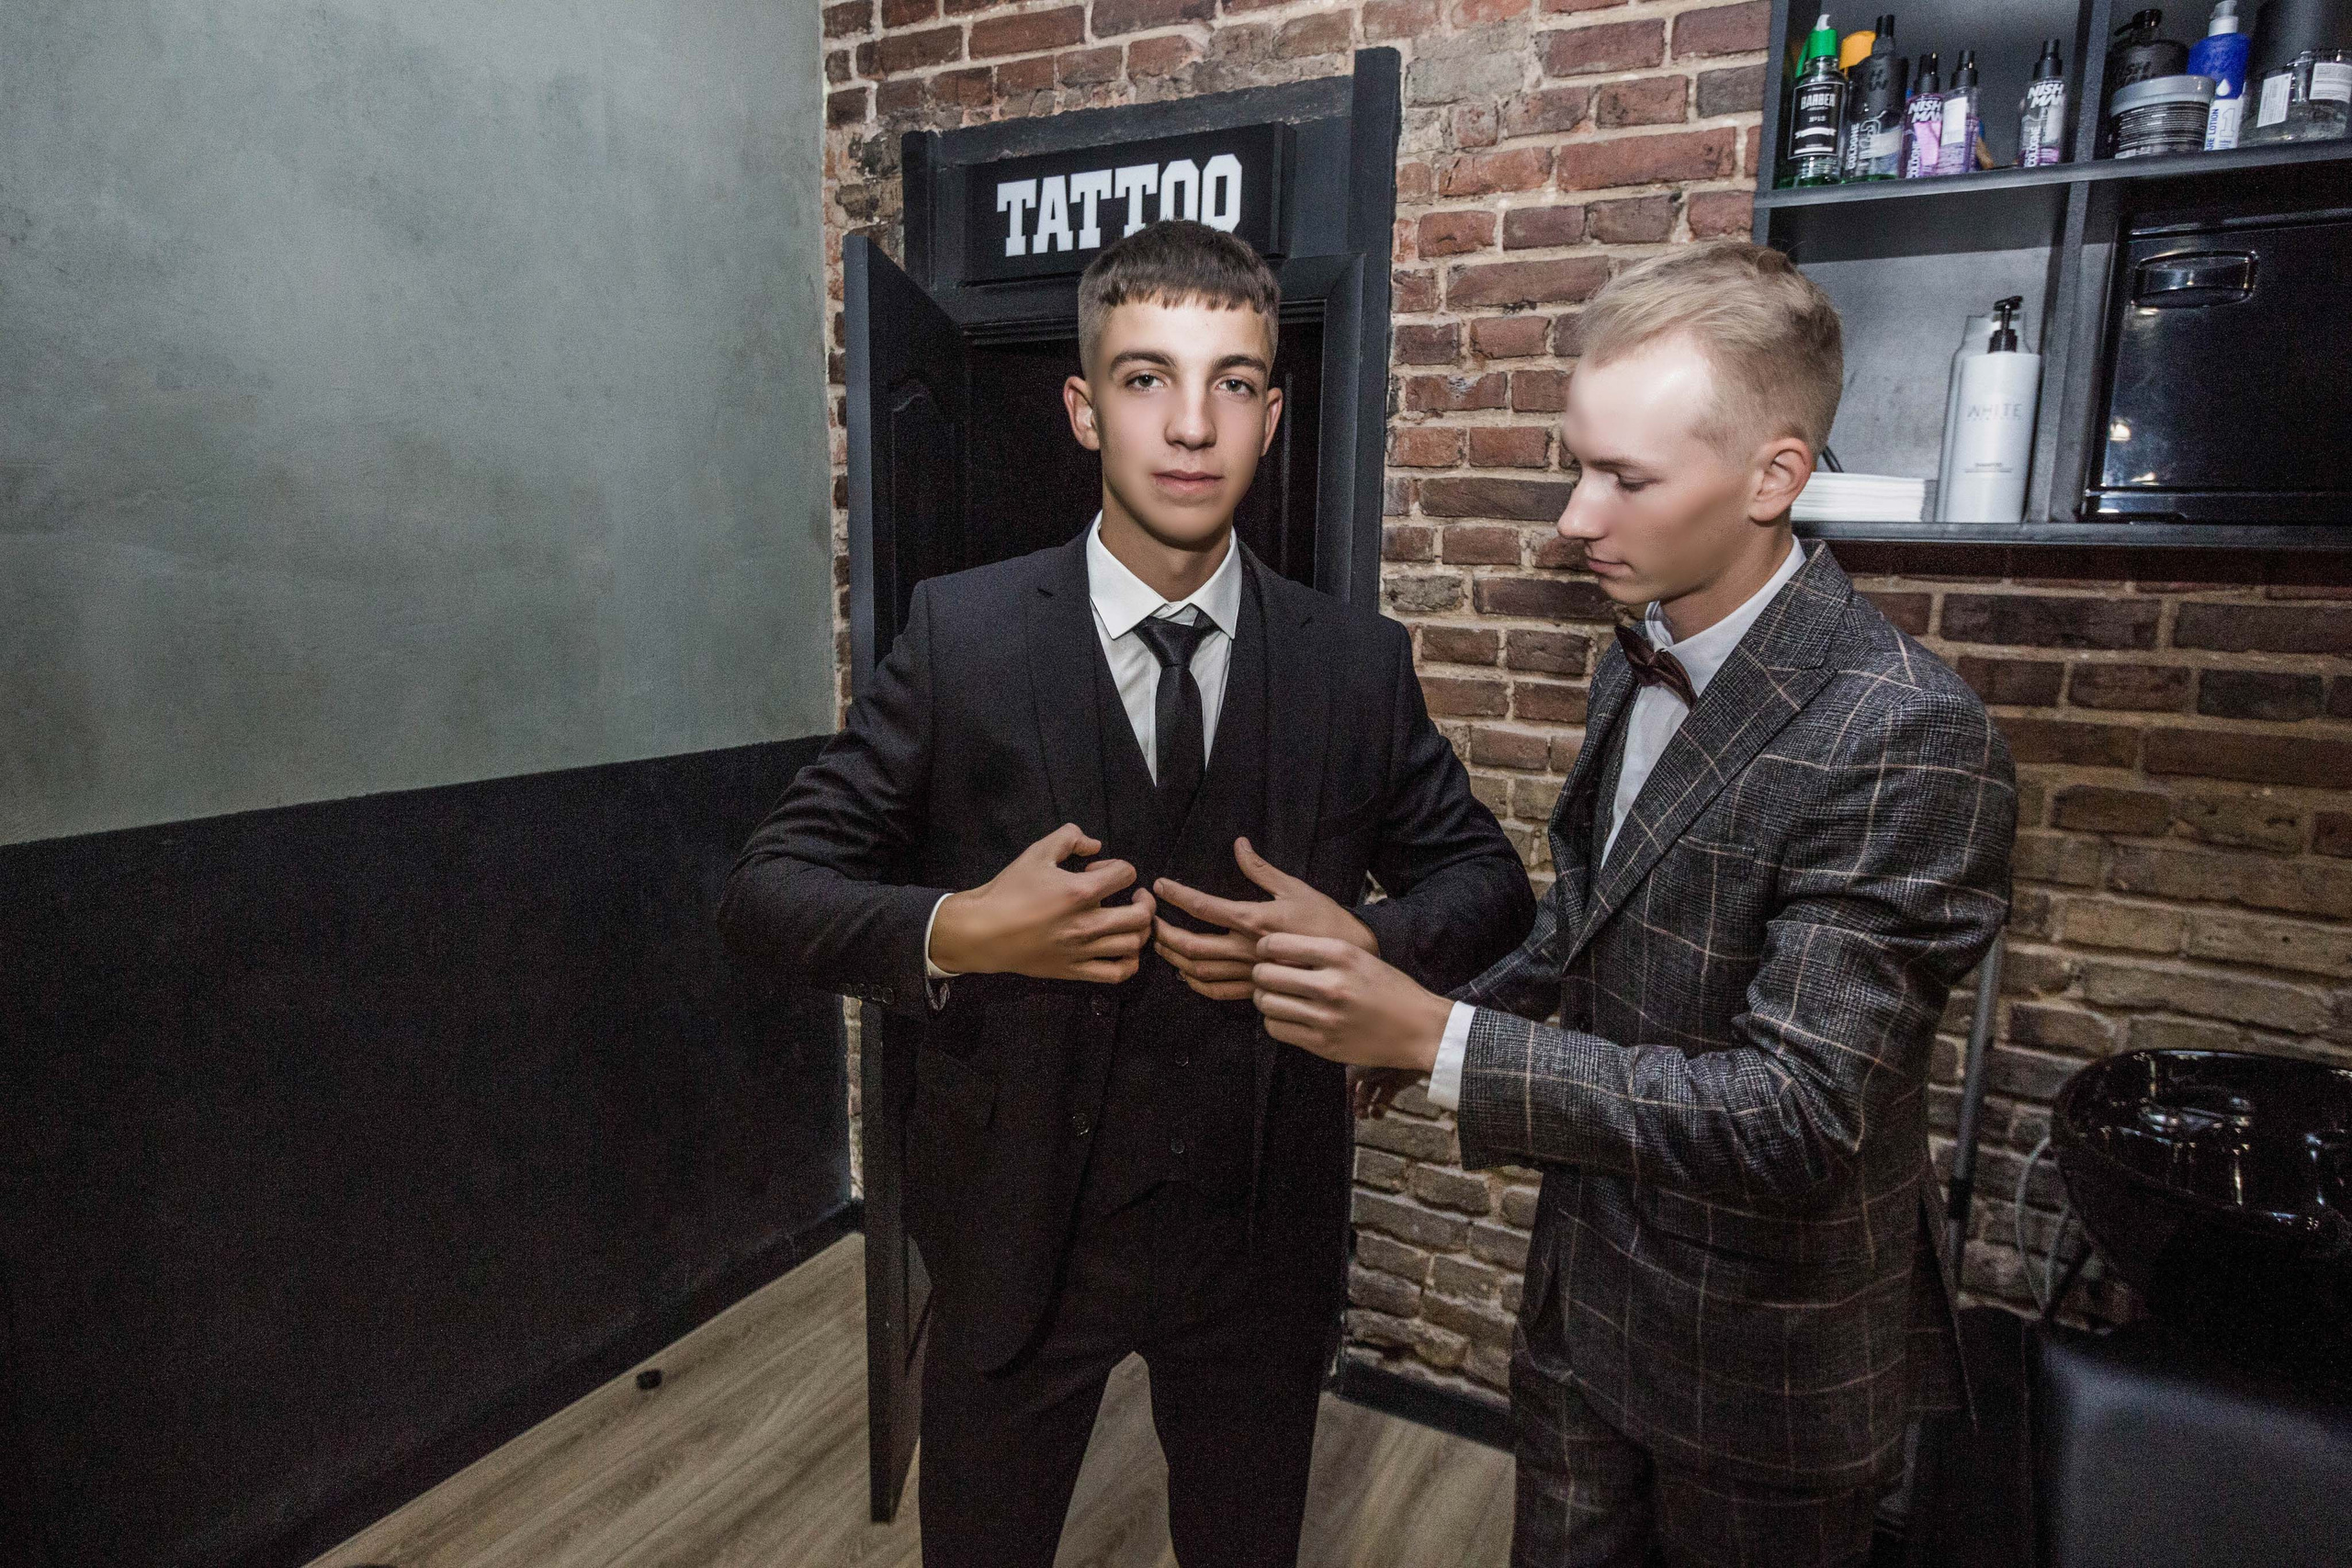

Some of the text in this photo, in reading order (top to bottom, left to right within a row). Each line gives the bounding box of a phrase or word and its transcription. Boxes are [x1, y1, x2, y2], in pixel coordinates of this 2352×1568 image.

[1801, 93, 1836, 109] BARBER
[2027, 83, 2064, 99] NISH
[1908, 100, 1942, 115] NISH
[2208, 108, 2219, 135] LOTION
[1846, 123, 1860, 170] COLOGNE
[2025, 125, 2041, 167] COLOGNE
[997, 153, 1242, 257] TATTOO
